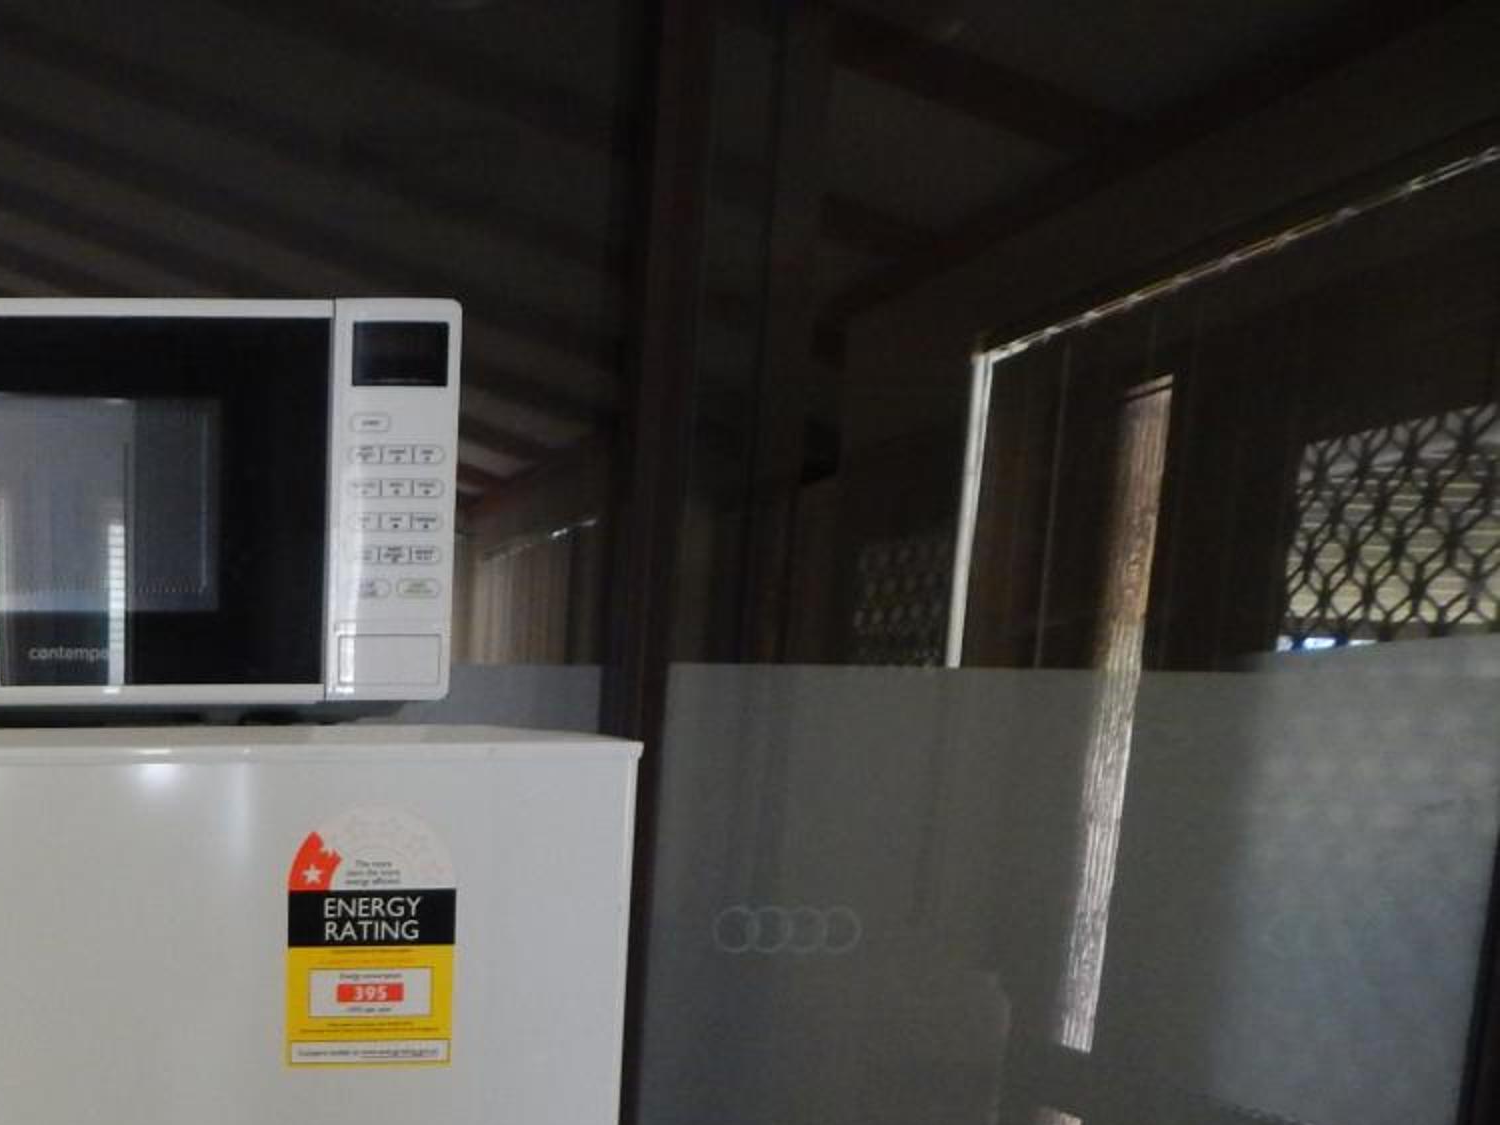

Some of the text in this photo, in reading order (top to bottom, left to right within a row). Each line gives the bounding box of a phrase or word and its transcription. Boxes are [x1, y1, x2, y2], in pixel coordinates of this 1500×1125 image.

[324, 896, 422, 918] ENERGY
[324, 920, 420, 941] RATING
[355, 985, 388, 1001] 395
